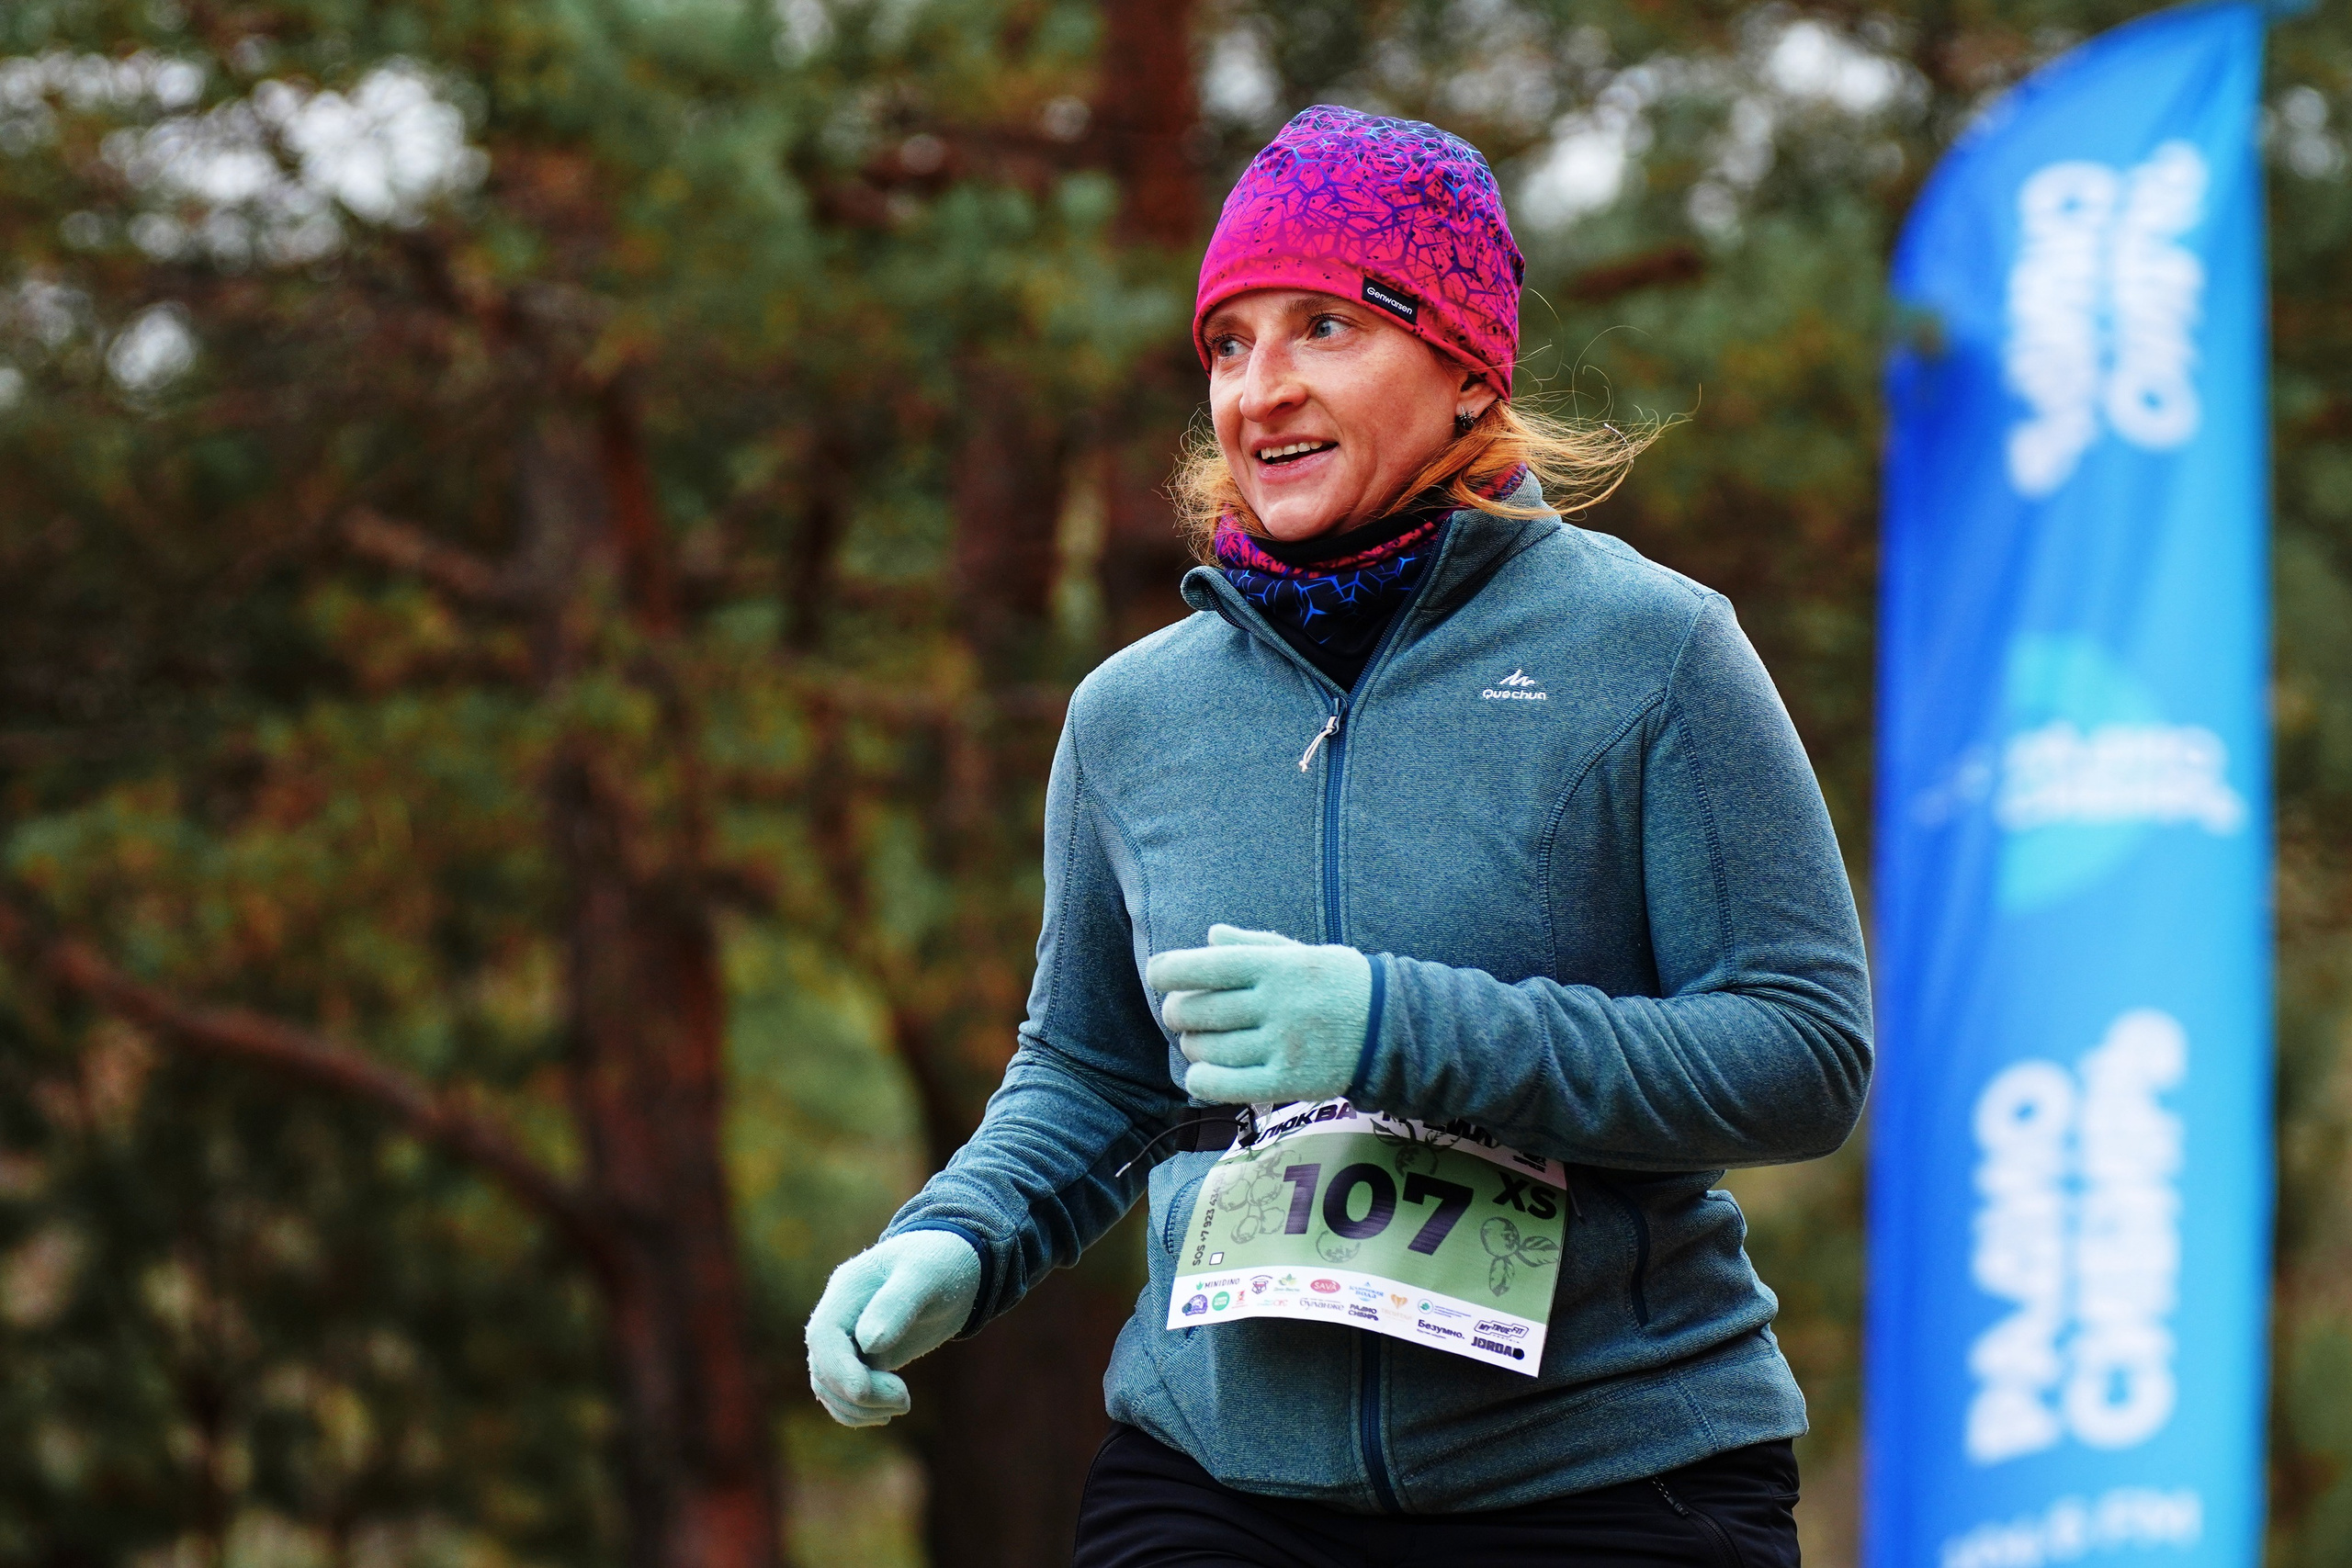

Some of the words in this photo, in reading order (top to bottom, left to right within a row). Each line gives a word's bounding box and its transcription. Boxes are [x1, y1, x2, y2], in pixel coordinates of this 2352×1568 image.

[1366, 287, 1413, 315] Genwarsen
[1482, 688, 1546, 700] Quechua
[1256, 1102, 1357, 1145] ЛЮКВА
[1203, 1208, 1216, 1228] 923
[1283, 1162, 1475, 1257] 107
[1493, 1170, 1557, 1220] XS
[1200, 1230, 1210, 1243] +7
[1192, 1244, 1206, 1267] SOS
[1204, 1278, 1240, 1289] MINIDINO
[1313, 1280, 1338, 1292] SAVA
[1418, 1318, 1465, 1340] Безумно.
[1471, 1336, 1524, 1360] JORDA
